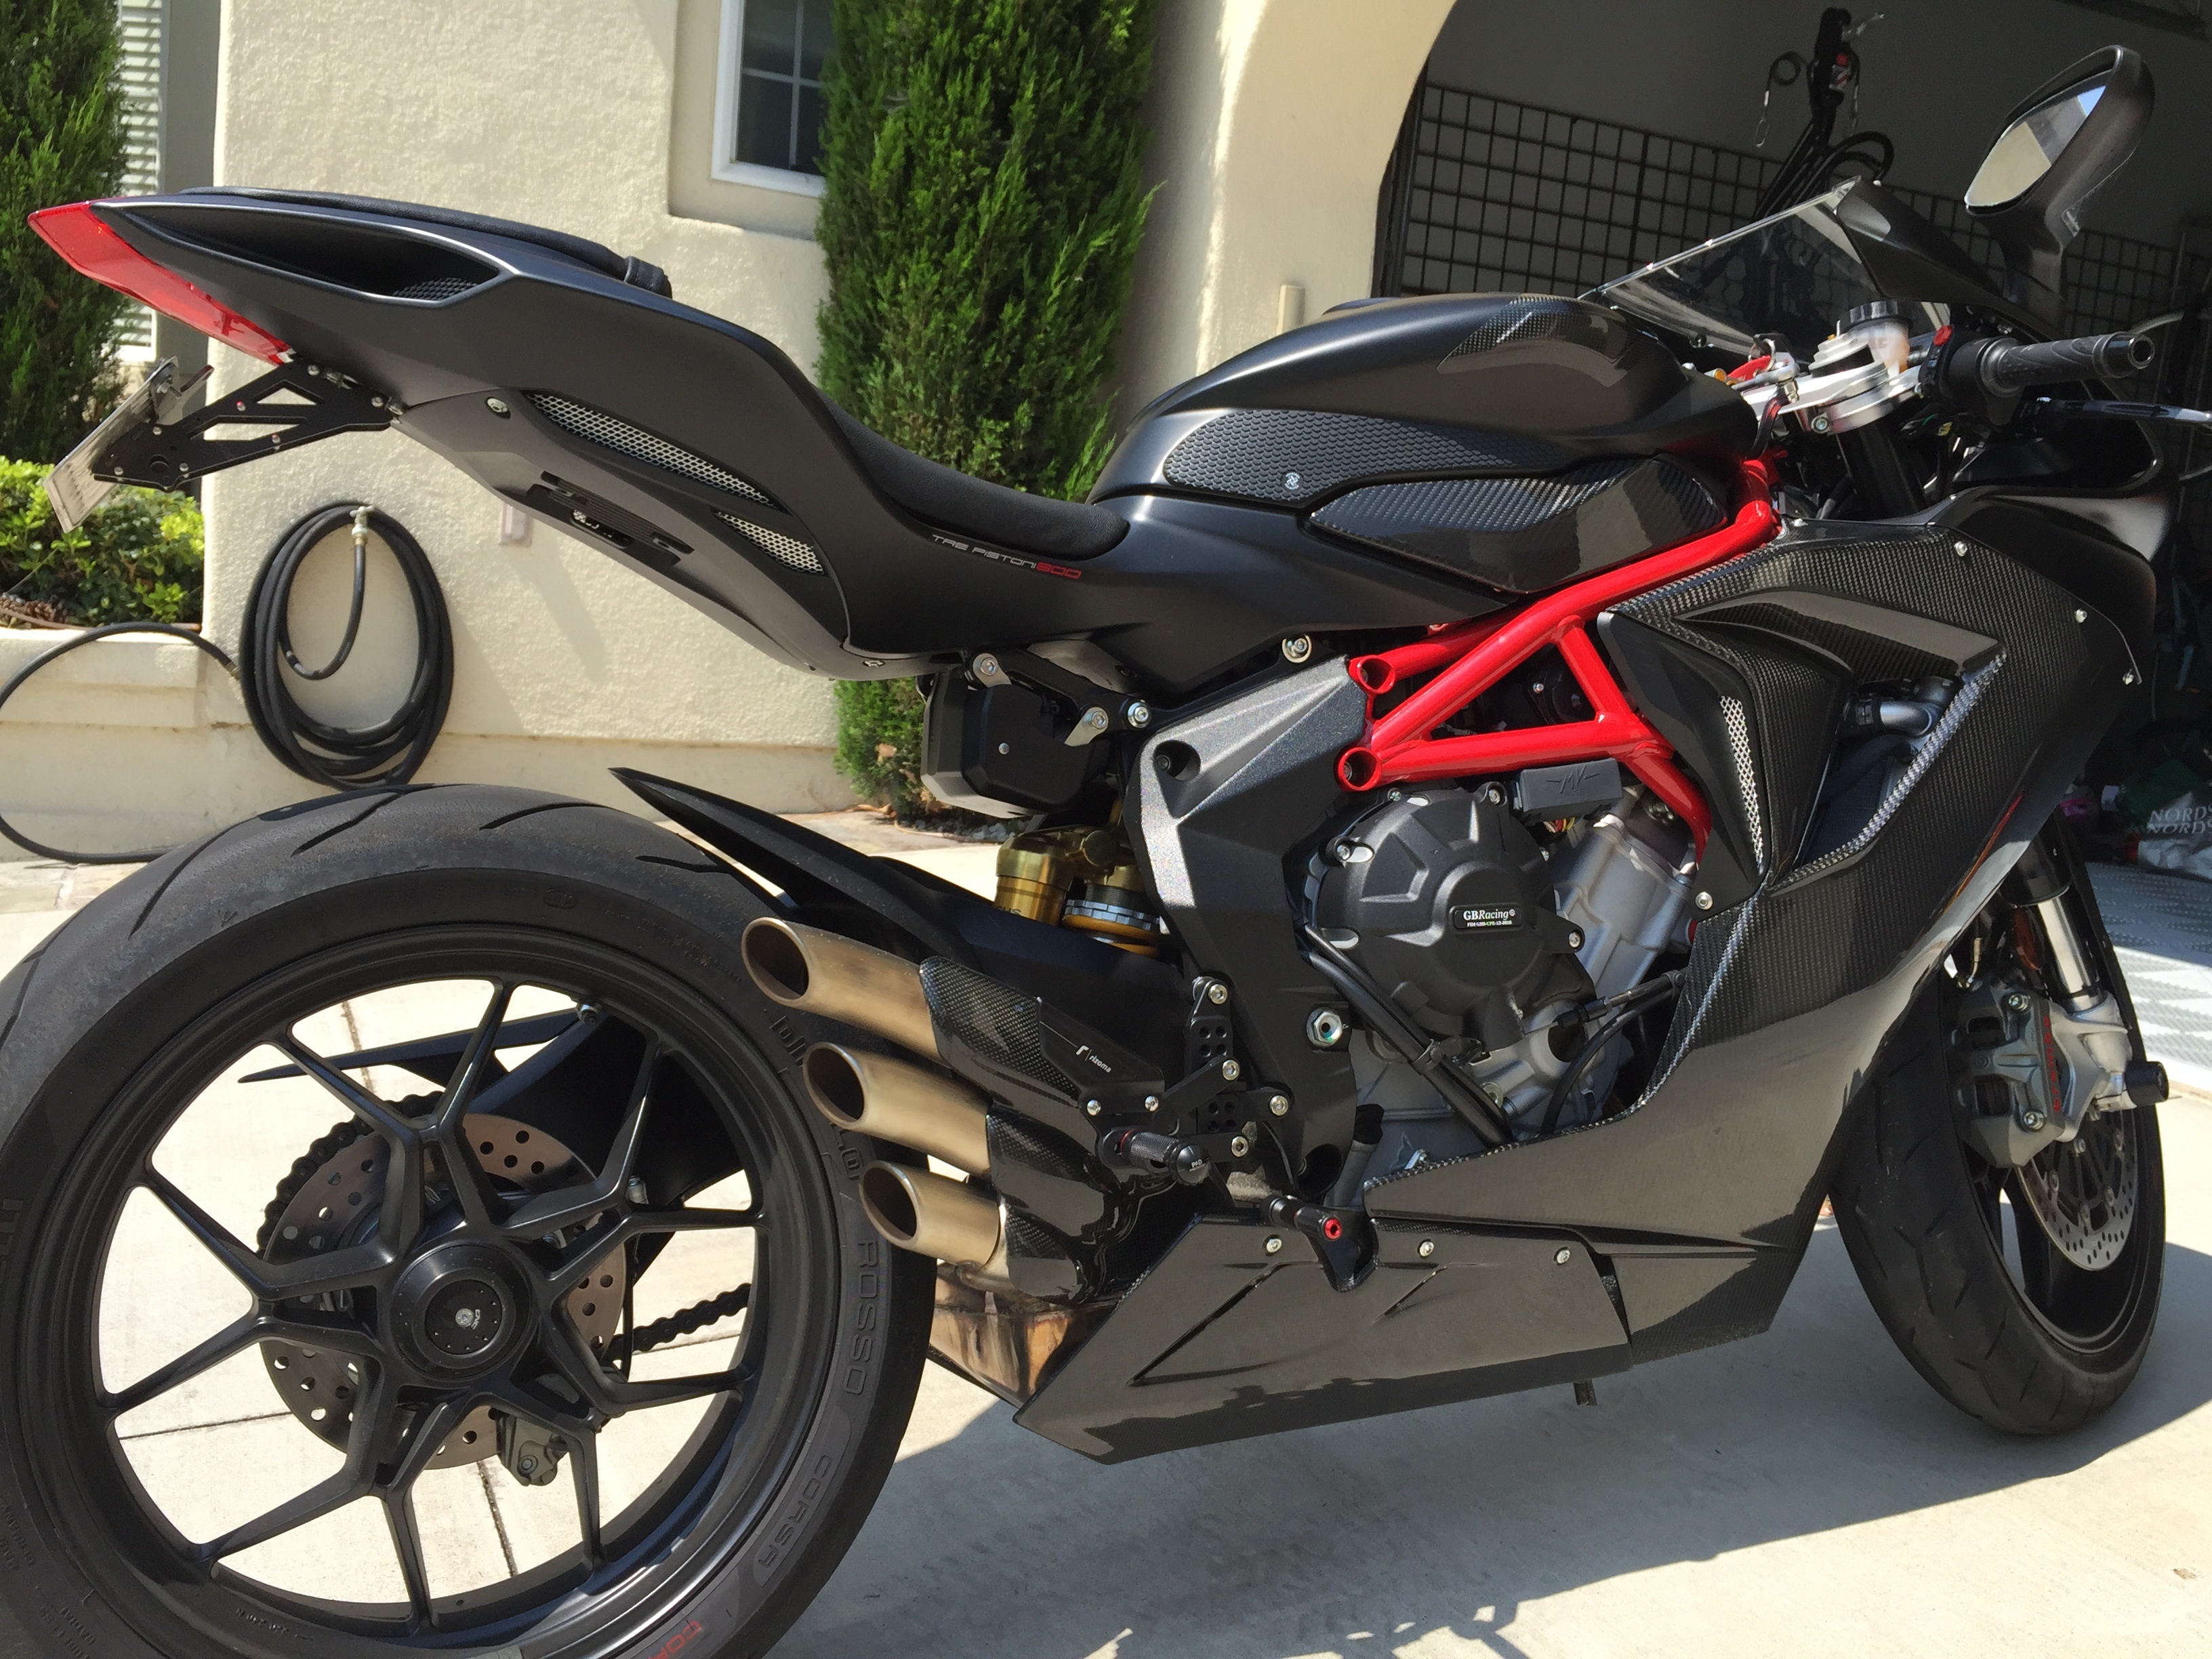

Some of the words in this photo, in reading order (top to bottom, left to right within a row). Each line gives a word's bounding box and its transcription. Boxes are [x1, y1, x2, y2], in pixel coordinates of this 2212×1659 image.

[933, 534, 970, 551] TRE
[1036, 561, 1082, 579] 800
[1088, 1055, 1112, 1073] rizoma
[2044, 1016, 2062, 1112] brembo
[846, 1238, 878, 1395] ROSSO
[758, 1455, 834, 1569] CORSA
